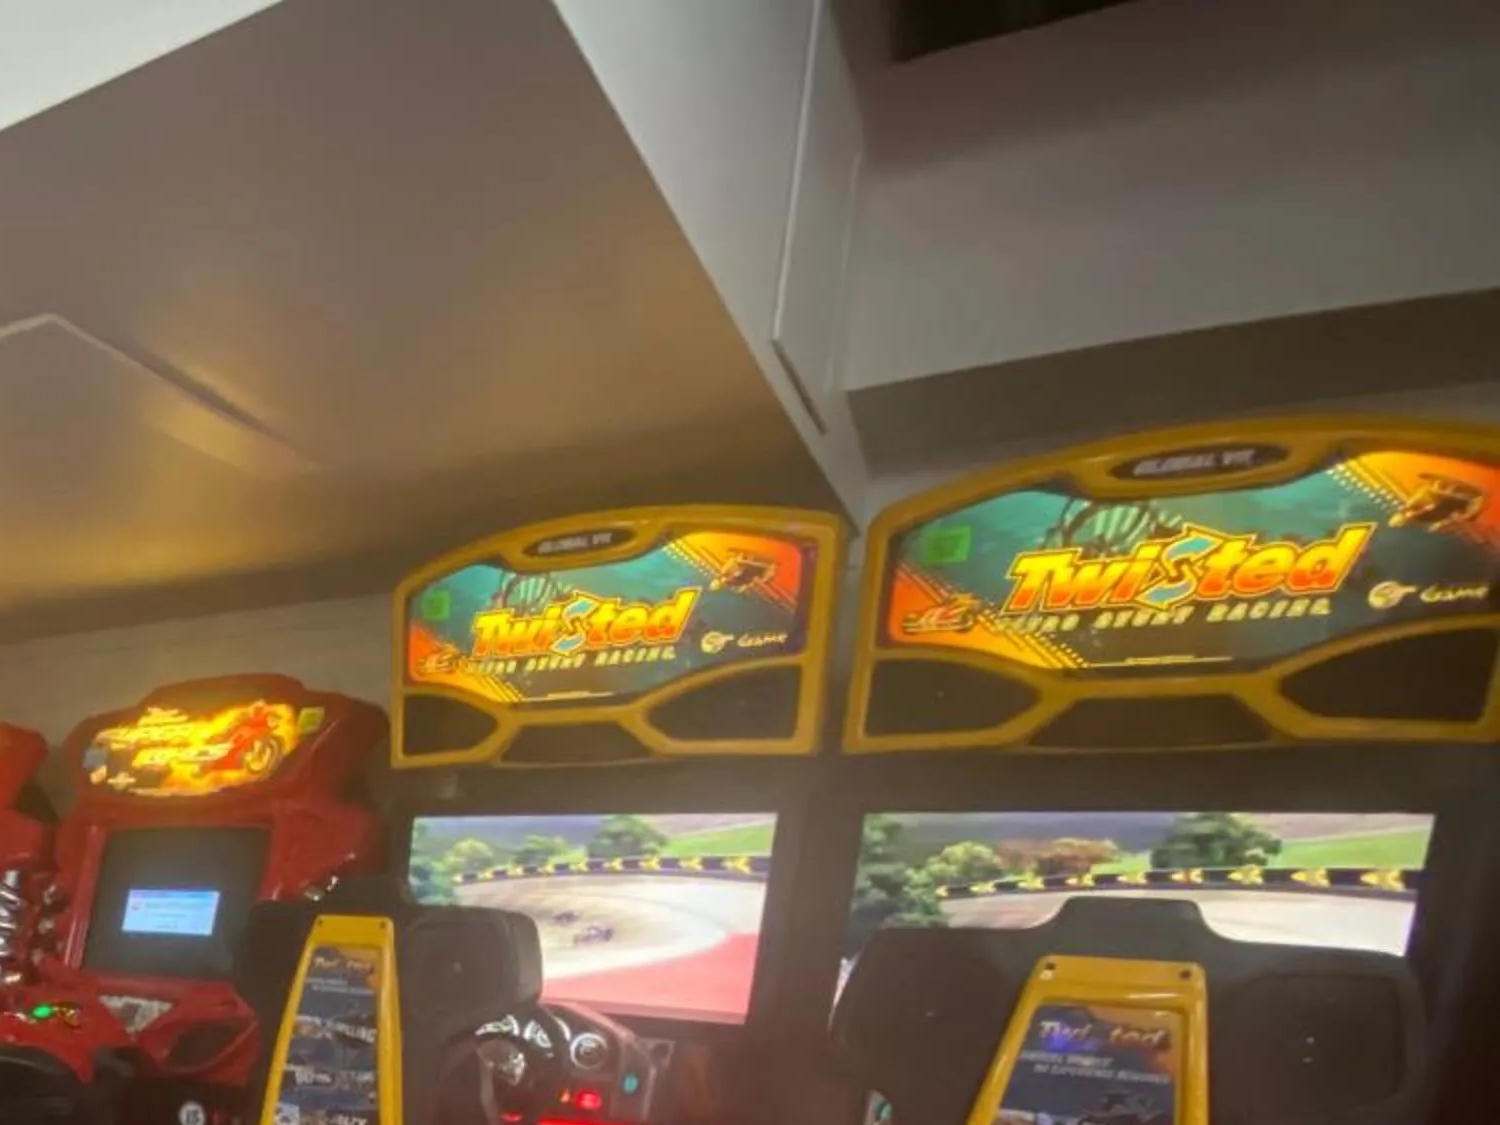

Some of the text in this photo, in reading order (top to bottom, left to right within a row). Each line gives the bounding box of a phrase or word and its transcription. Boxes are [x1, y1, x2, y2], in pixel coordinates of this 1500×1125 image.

[1004, 522, 1378, 613] Twisted
[471, 586, 703, 657] Twisted
[1206, 598, 1331, 622] RACING
[595, 645, 677, 668] RACING
